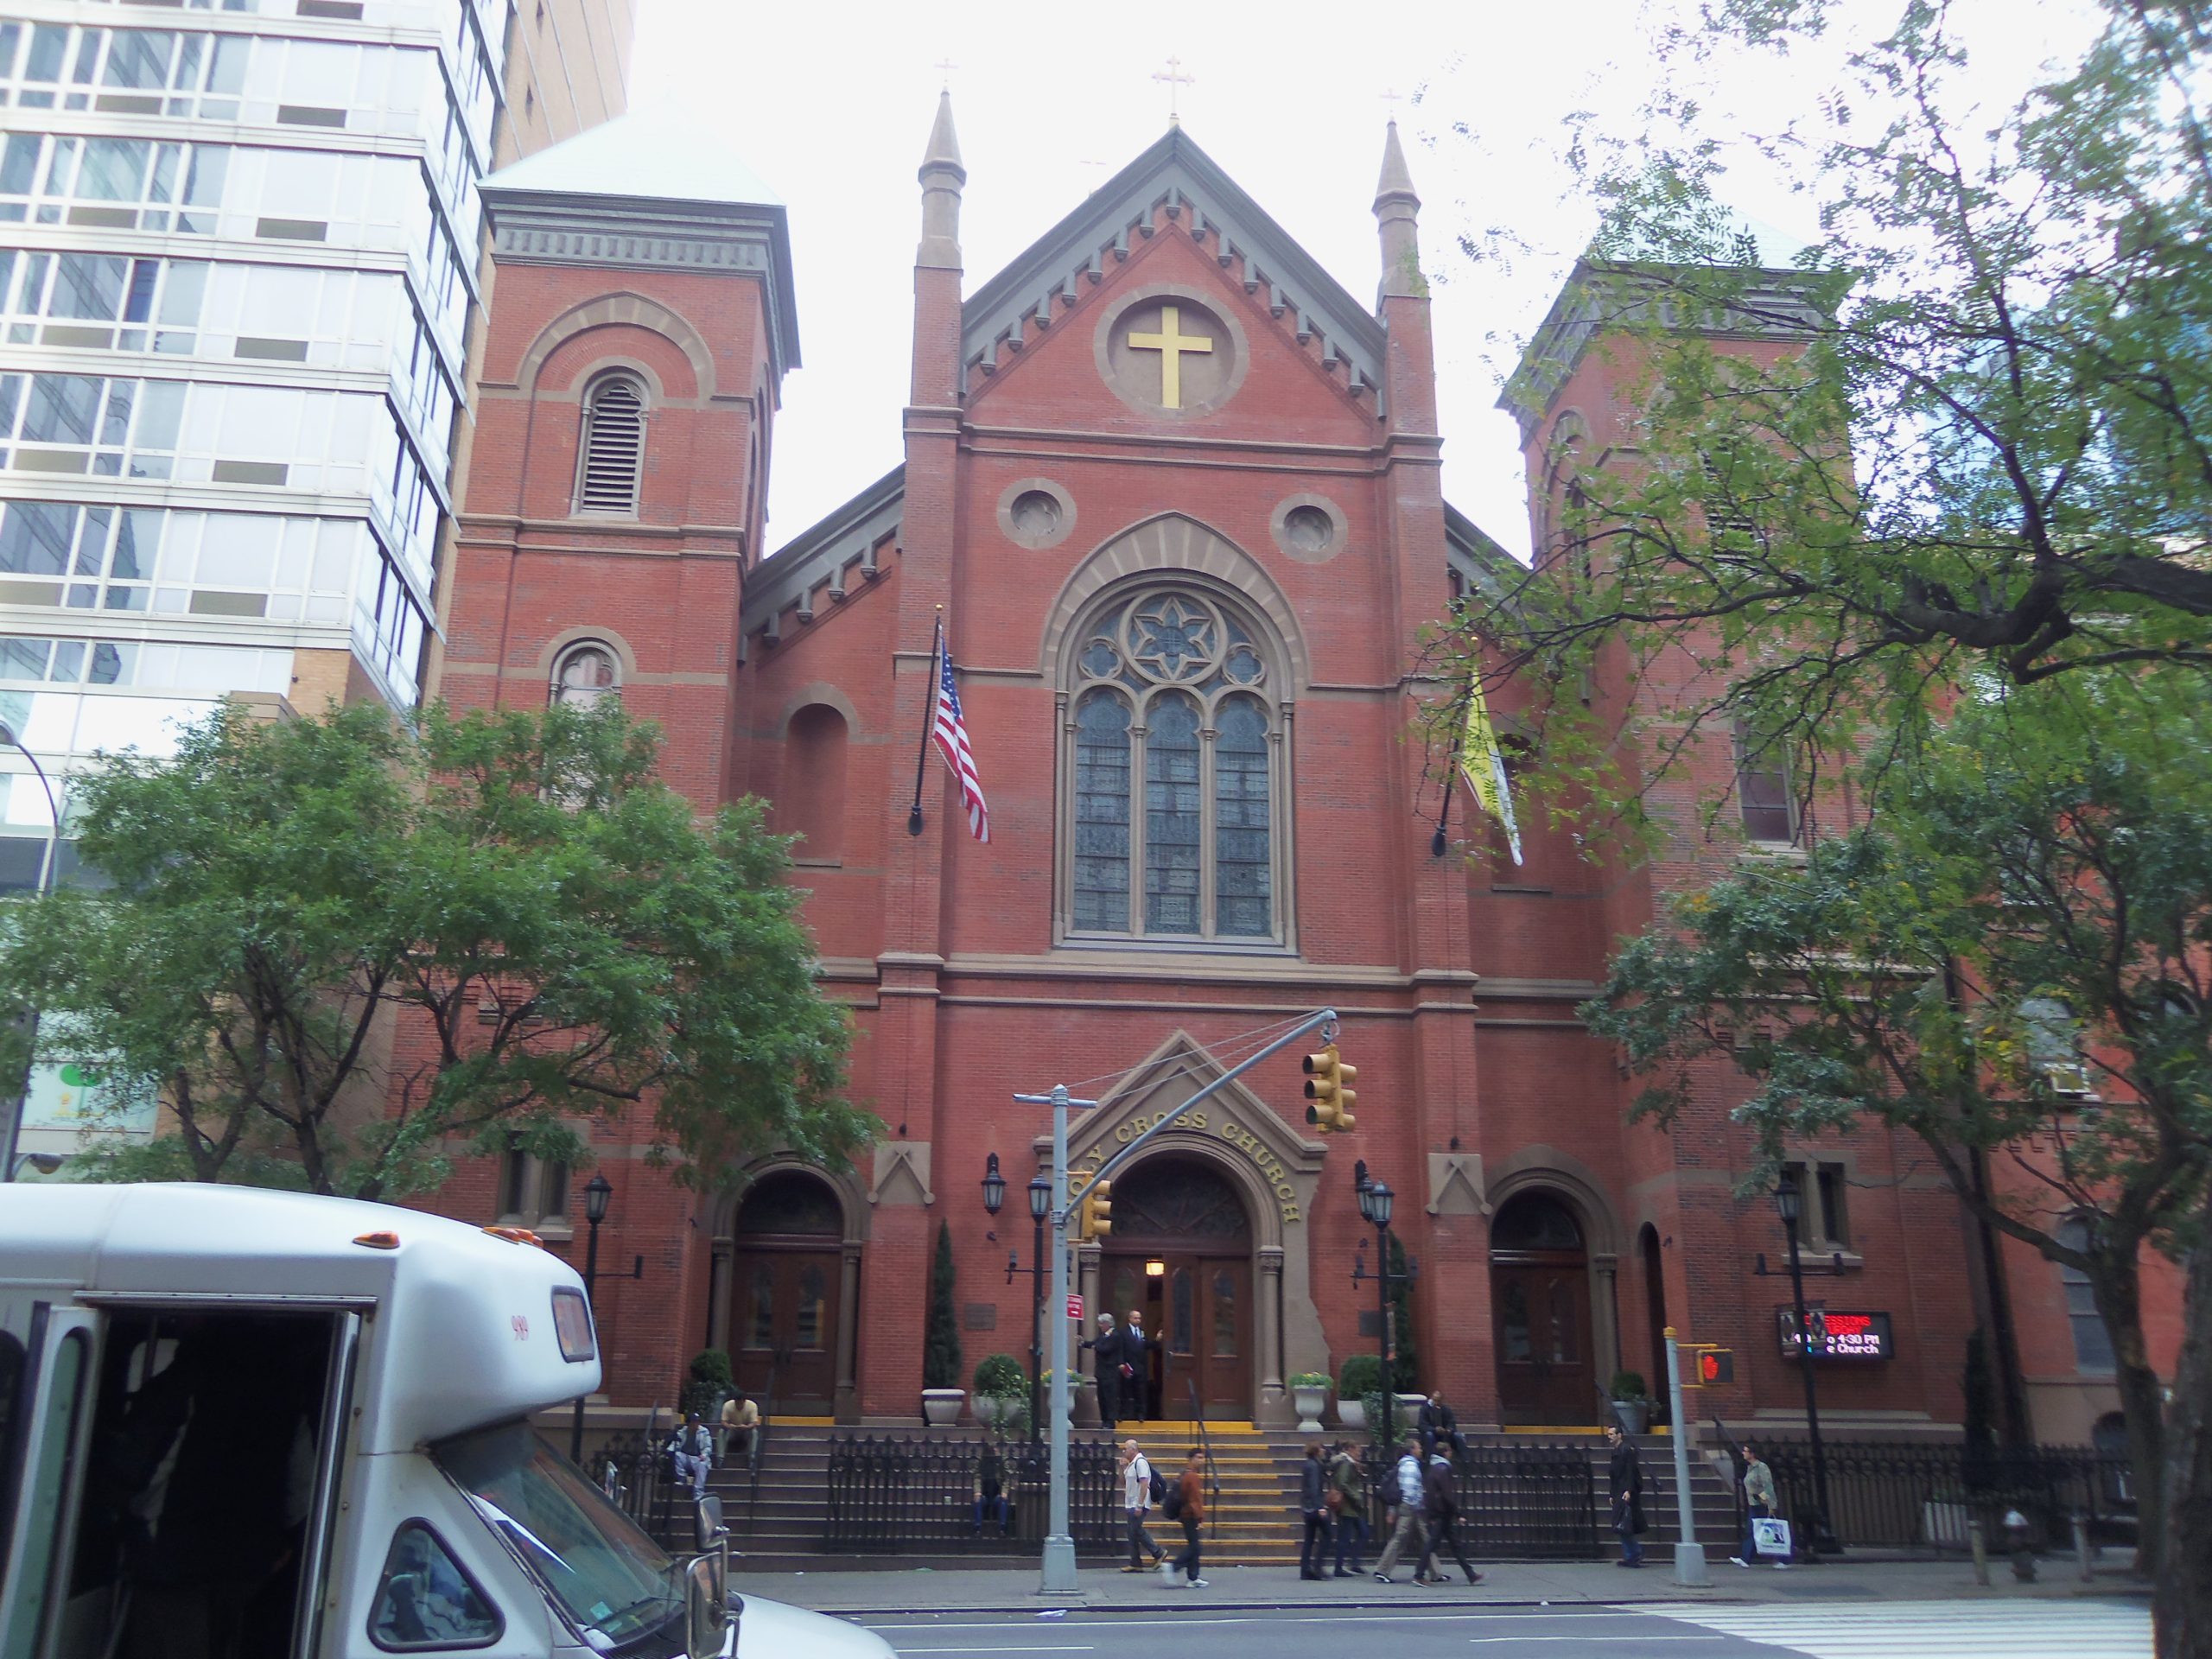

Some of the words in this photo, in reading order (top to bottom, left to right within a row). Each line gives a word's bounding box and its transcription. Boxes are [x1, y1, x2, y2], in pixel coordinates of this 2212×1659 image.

[1116, 1112, 1207, 1142] CROSS
[1221, 1122, 1300, 1222] CHURCH
[1836, 1344, 1879, 1354] Church
